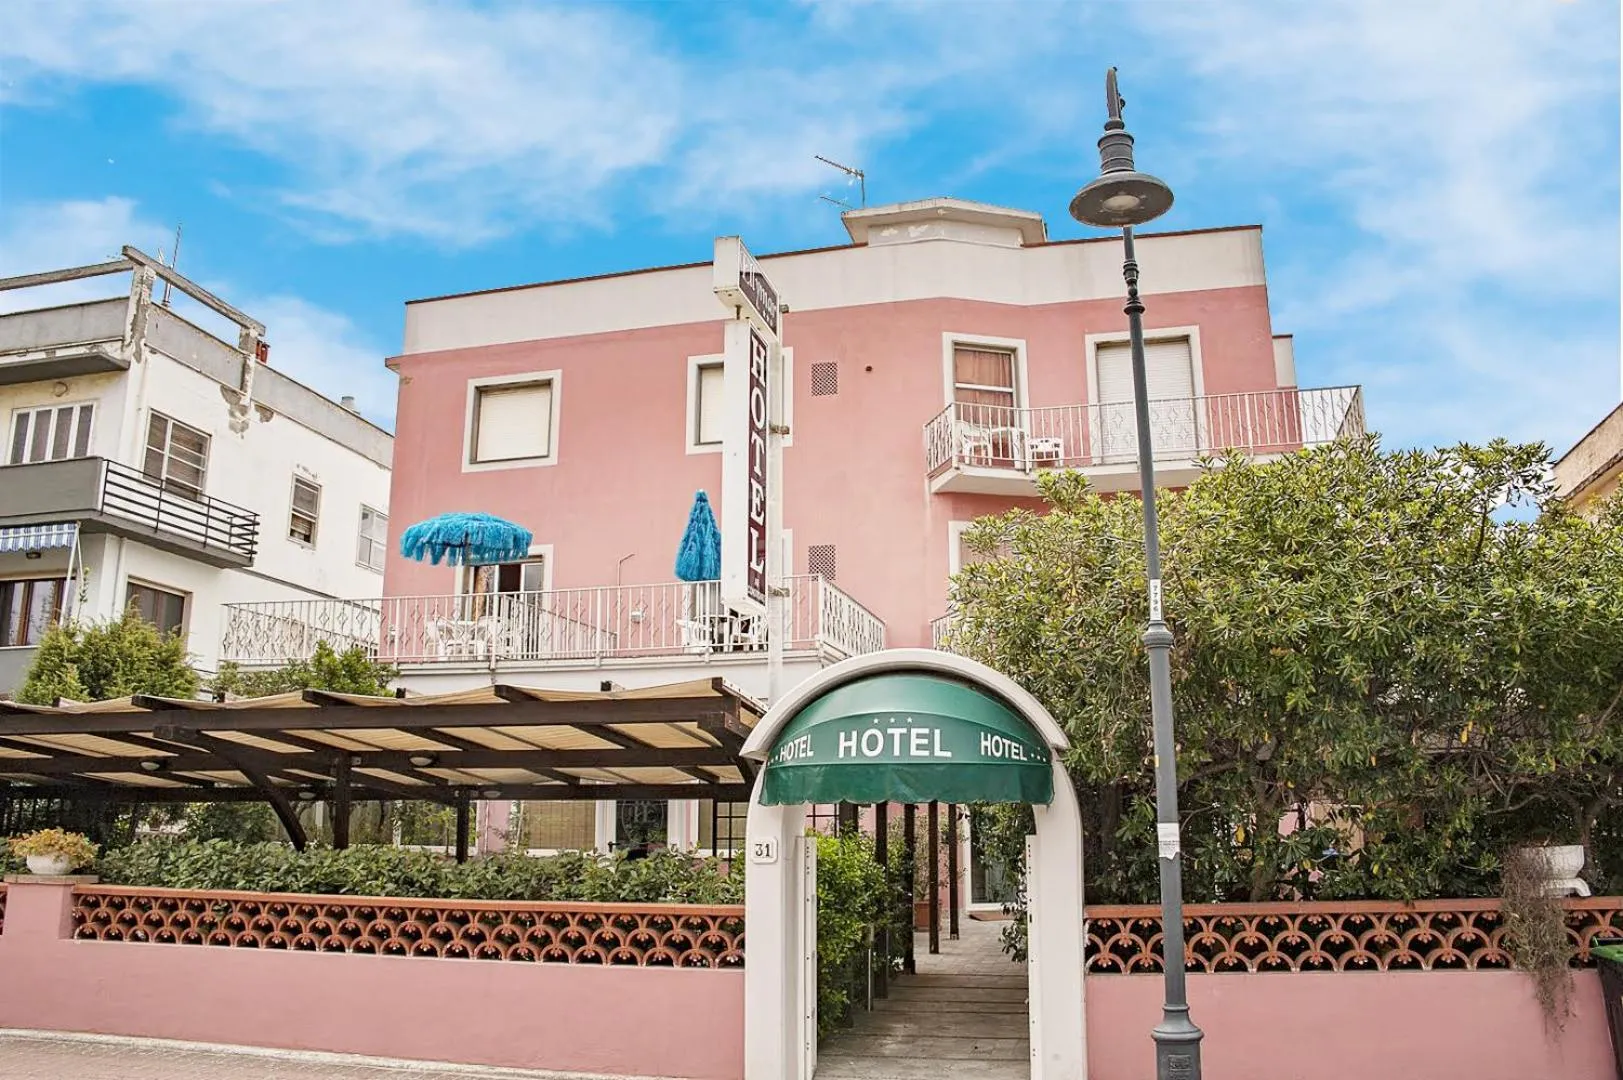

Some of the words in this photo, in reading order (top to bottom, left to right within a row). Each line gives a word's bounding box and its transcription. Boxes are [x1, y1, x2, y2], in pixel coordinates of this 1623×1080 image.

[750, 334, 766, 574] HOTEL
[779, 734, 814, 762] HOTEL
[838, 727, 952, 759] HOTEL
[980, 731, 1028, 761] HOTEL
[755, 843, 770, 857] 31
